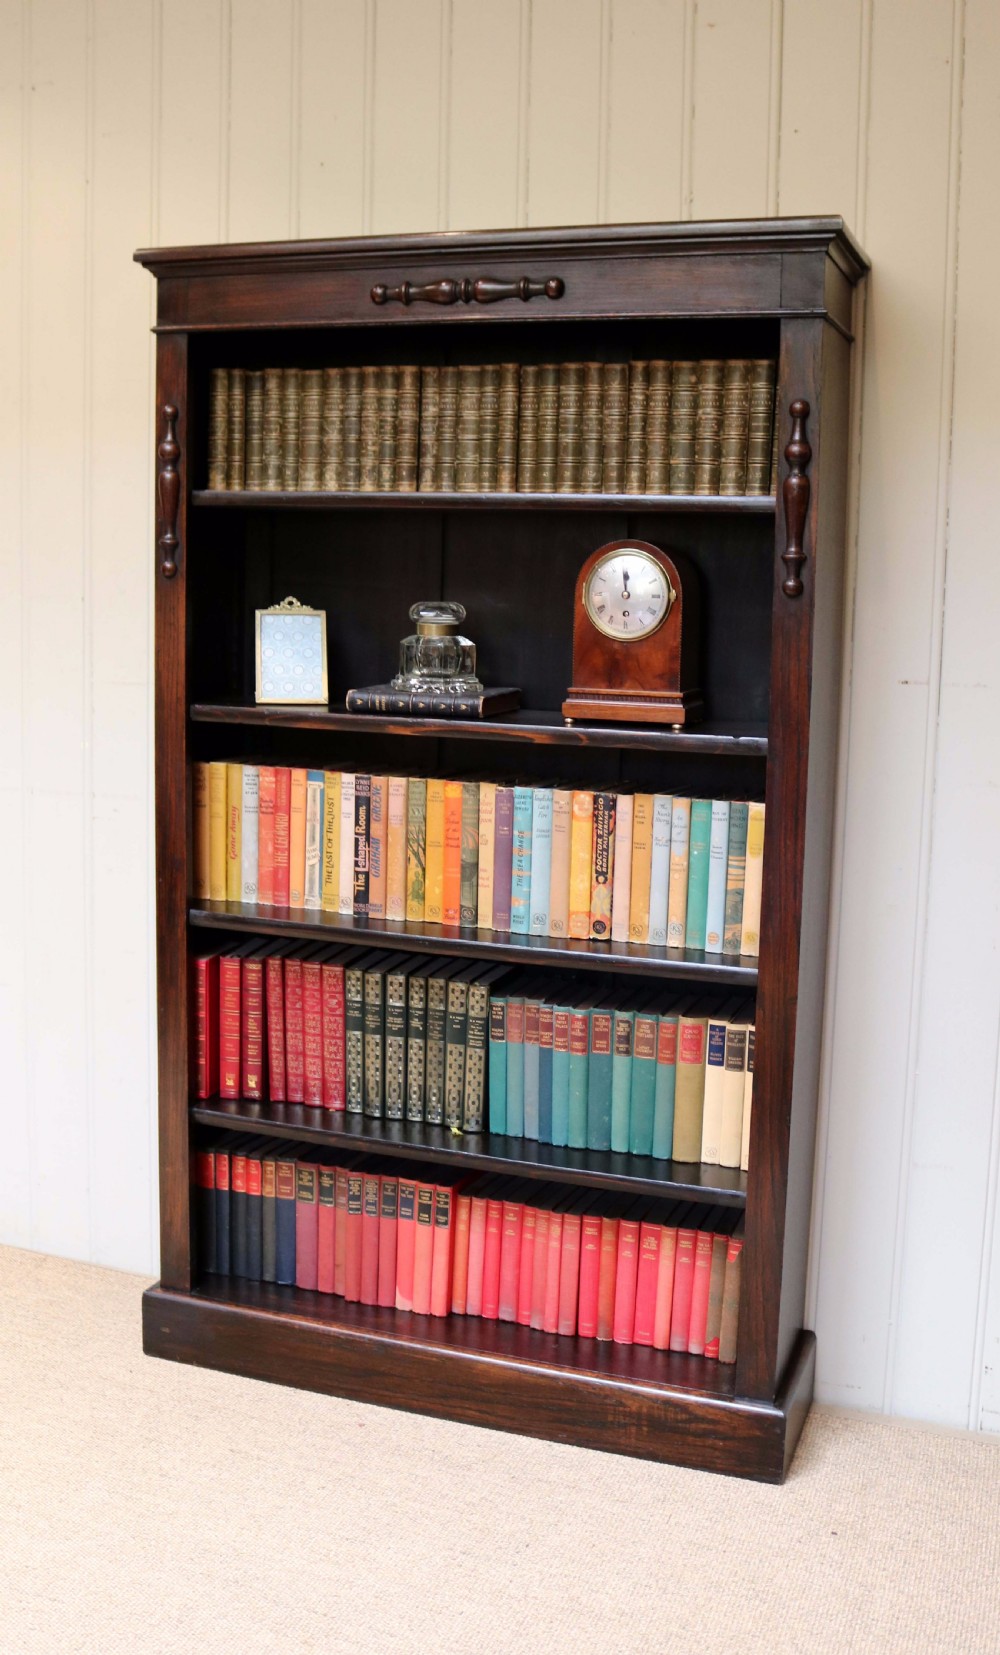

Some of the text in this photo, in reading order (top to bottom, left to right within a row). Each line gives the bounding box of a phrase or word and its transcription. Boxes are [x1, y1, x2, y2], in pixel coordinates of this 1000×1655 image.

[326, 792, 336, 819] JUST
[273, 812, 289, 867] THE LEOPARD
[326, 819, 335, 835] THE
[326, 836, 335, 849] OF
[370, 784, 382, 878] GRAHAM GREENE
[325, 850, 335, 870] LAST
[354, 804, 370, 896] The L-shaped Room
[516, 830, 525, 887] THE SEA CHANGE
[596, 837, 604, 872] DOCTOR
[324, 868, 334, 888] THE
